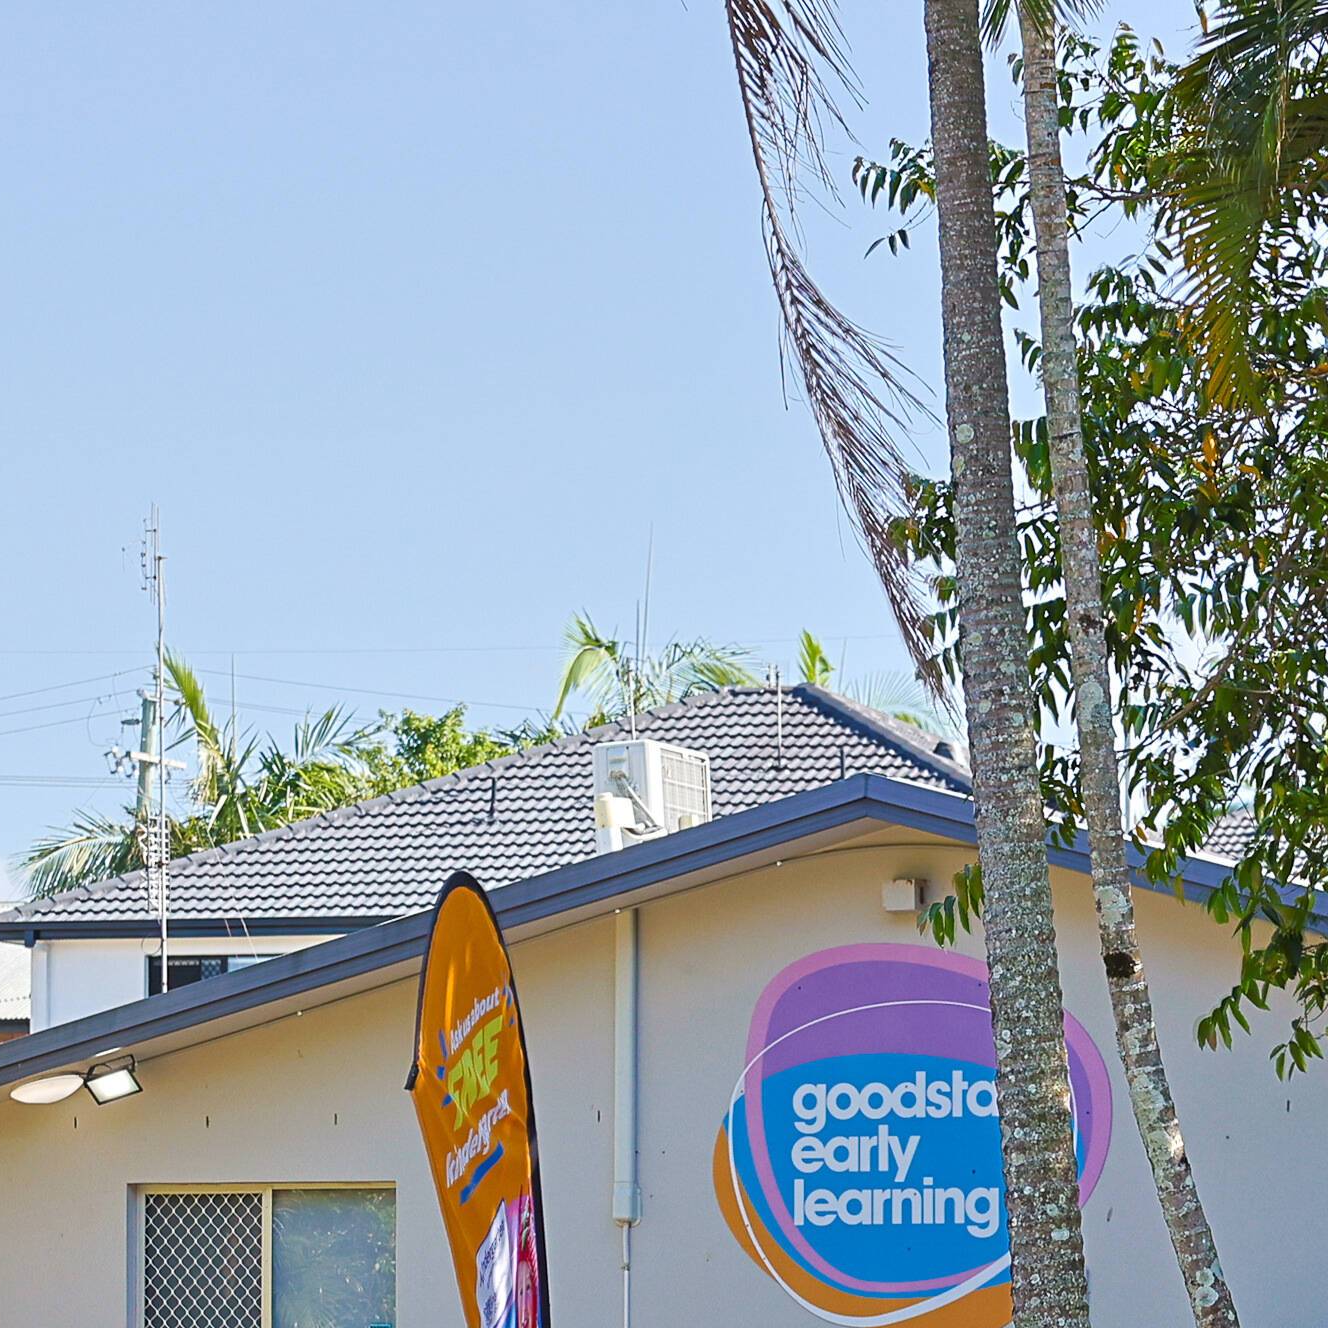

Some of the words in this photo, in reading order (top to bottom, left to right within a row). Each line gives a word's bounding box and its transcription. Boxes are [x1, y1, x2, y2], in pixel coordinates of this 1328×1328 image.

[471, 986, 500, 1027] about
[447, 1014, 503, 1132] FREE
[792, 1070, 1000, 1134] goodsta
[791, 1124, 921, 1183] early
[793, 1176, 1000, 1238] learning
